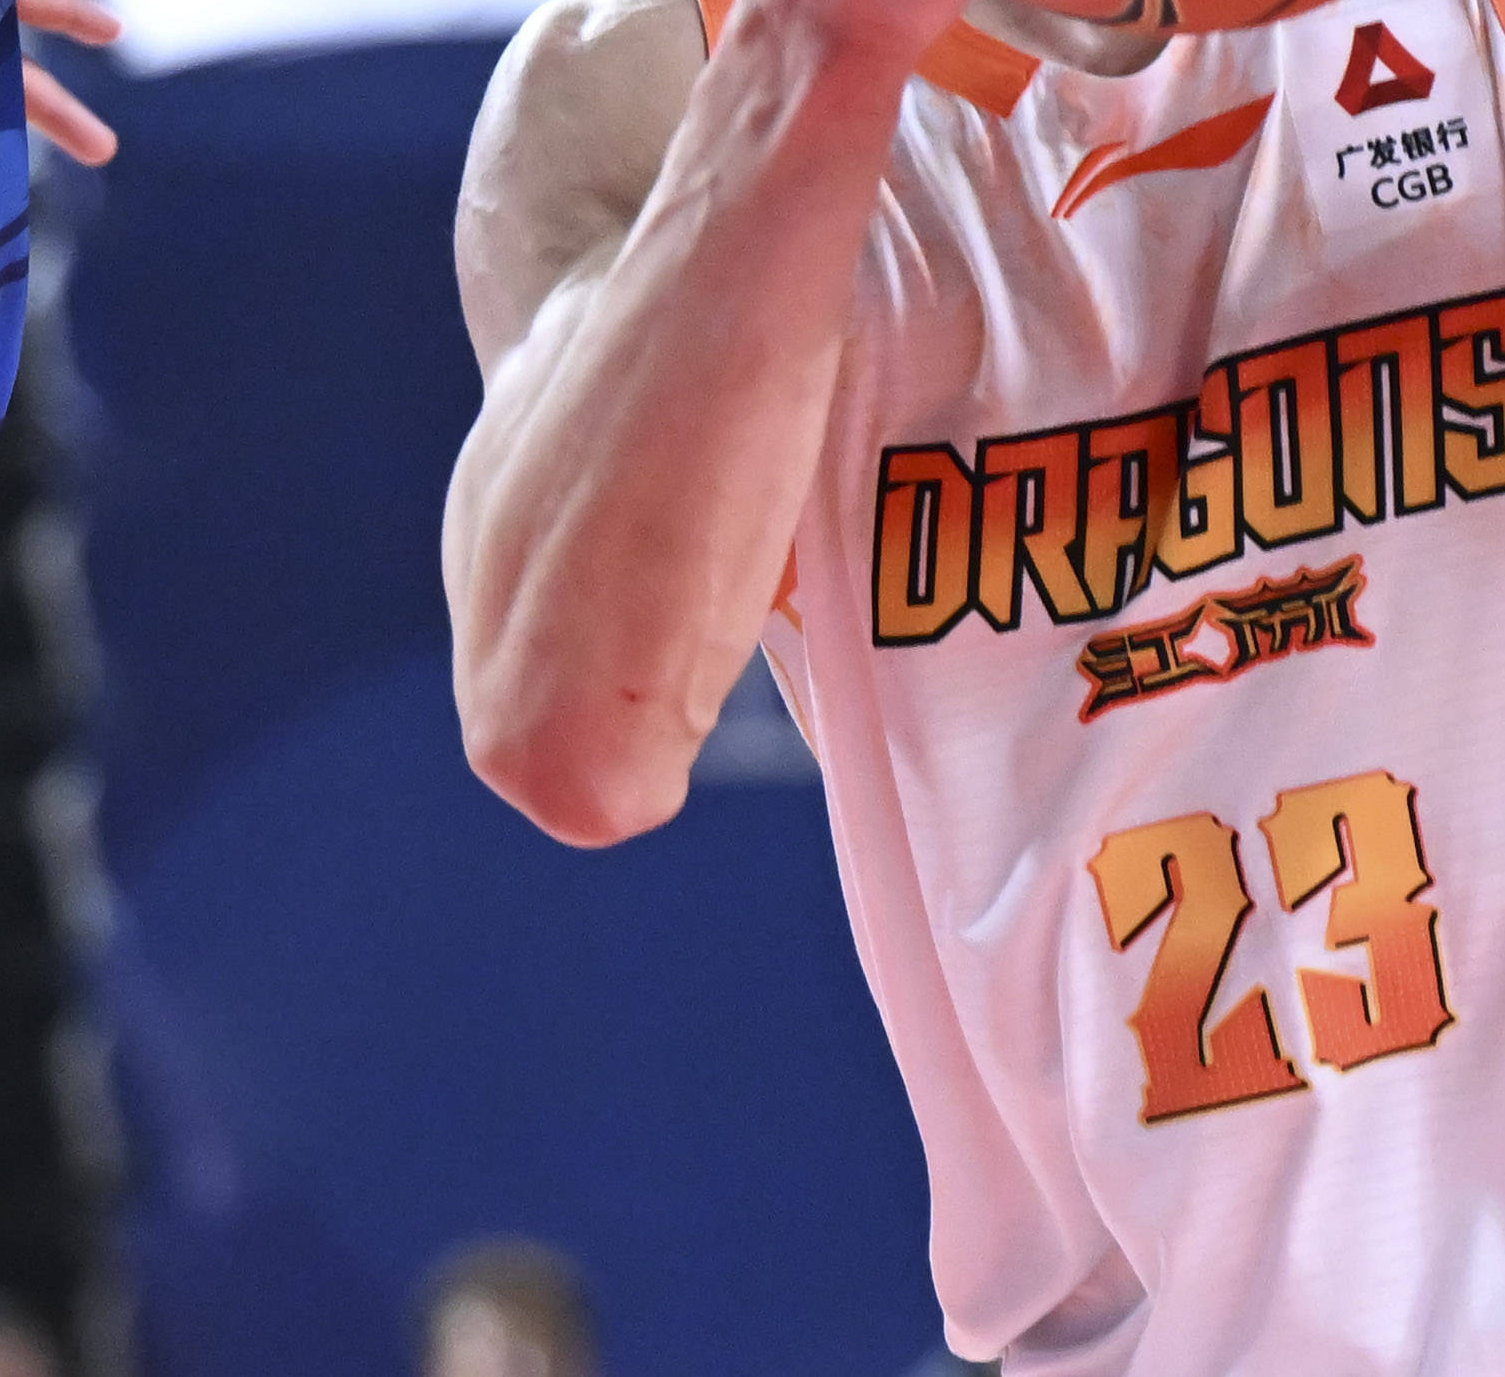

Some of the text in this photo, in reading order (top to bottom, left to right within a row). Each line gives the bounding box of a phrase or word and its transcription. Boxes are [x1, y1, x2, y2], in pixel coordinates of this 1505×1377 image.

[1335, 117, 1469, 180] 广发银行
[1370, 164, 1454, 210] CGB
[1087, 768, 1457, 1127] 23
